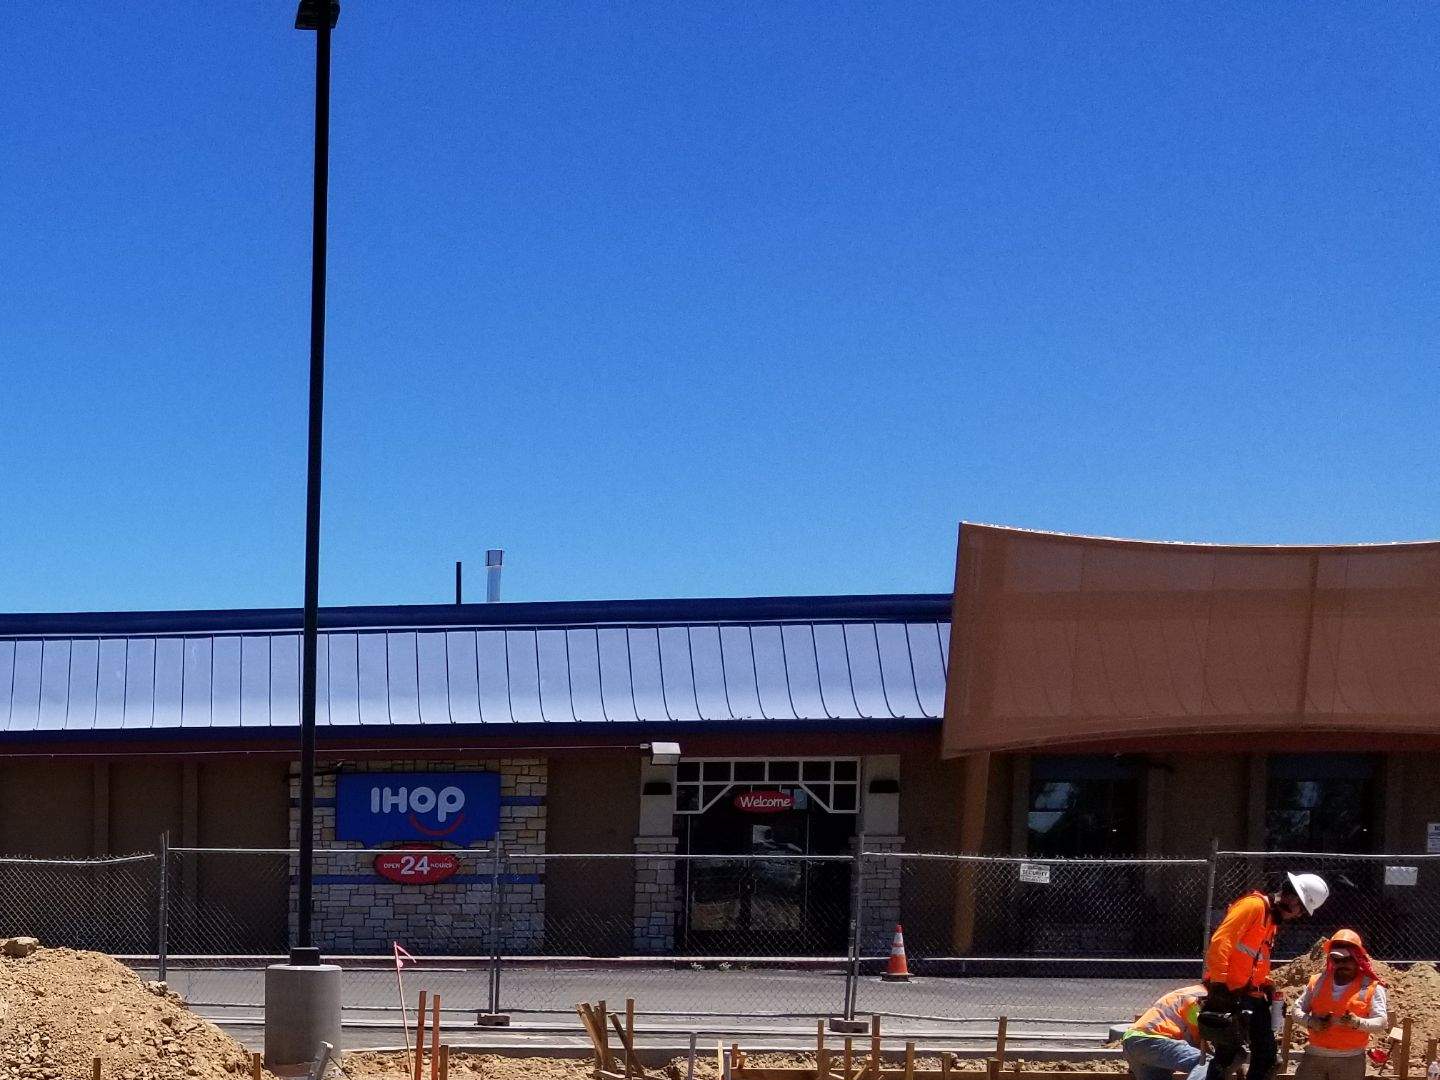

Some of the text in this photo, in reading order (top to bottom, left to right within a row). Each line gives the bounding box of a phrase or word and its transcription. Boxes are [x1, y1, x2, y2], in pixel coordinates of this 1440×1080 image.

[371, 786, 465, 822] IHOP
[740, 795, 792, 808] Welcome
[400, 855, 431, 875] 24
